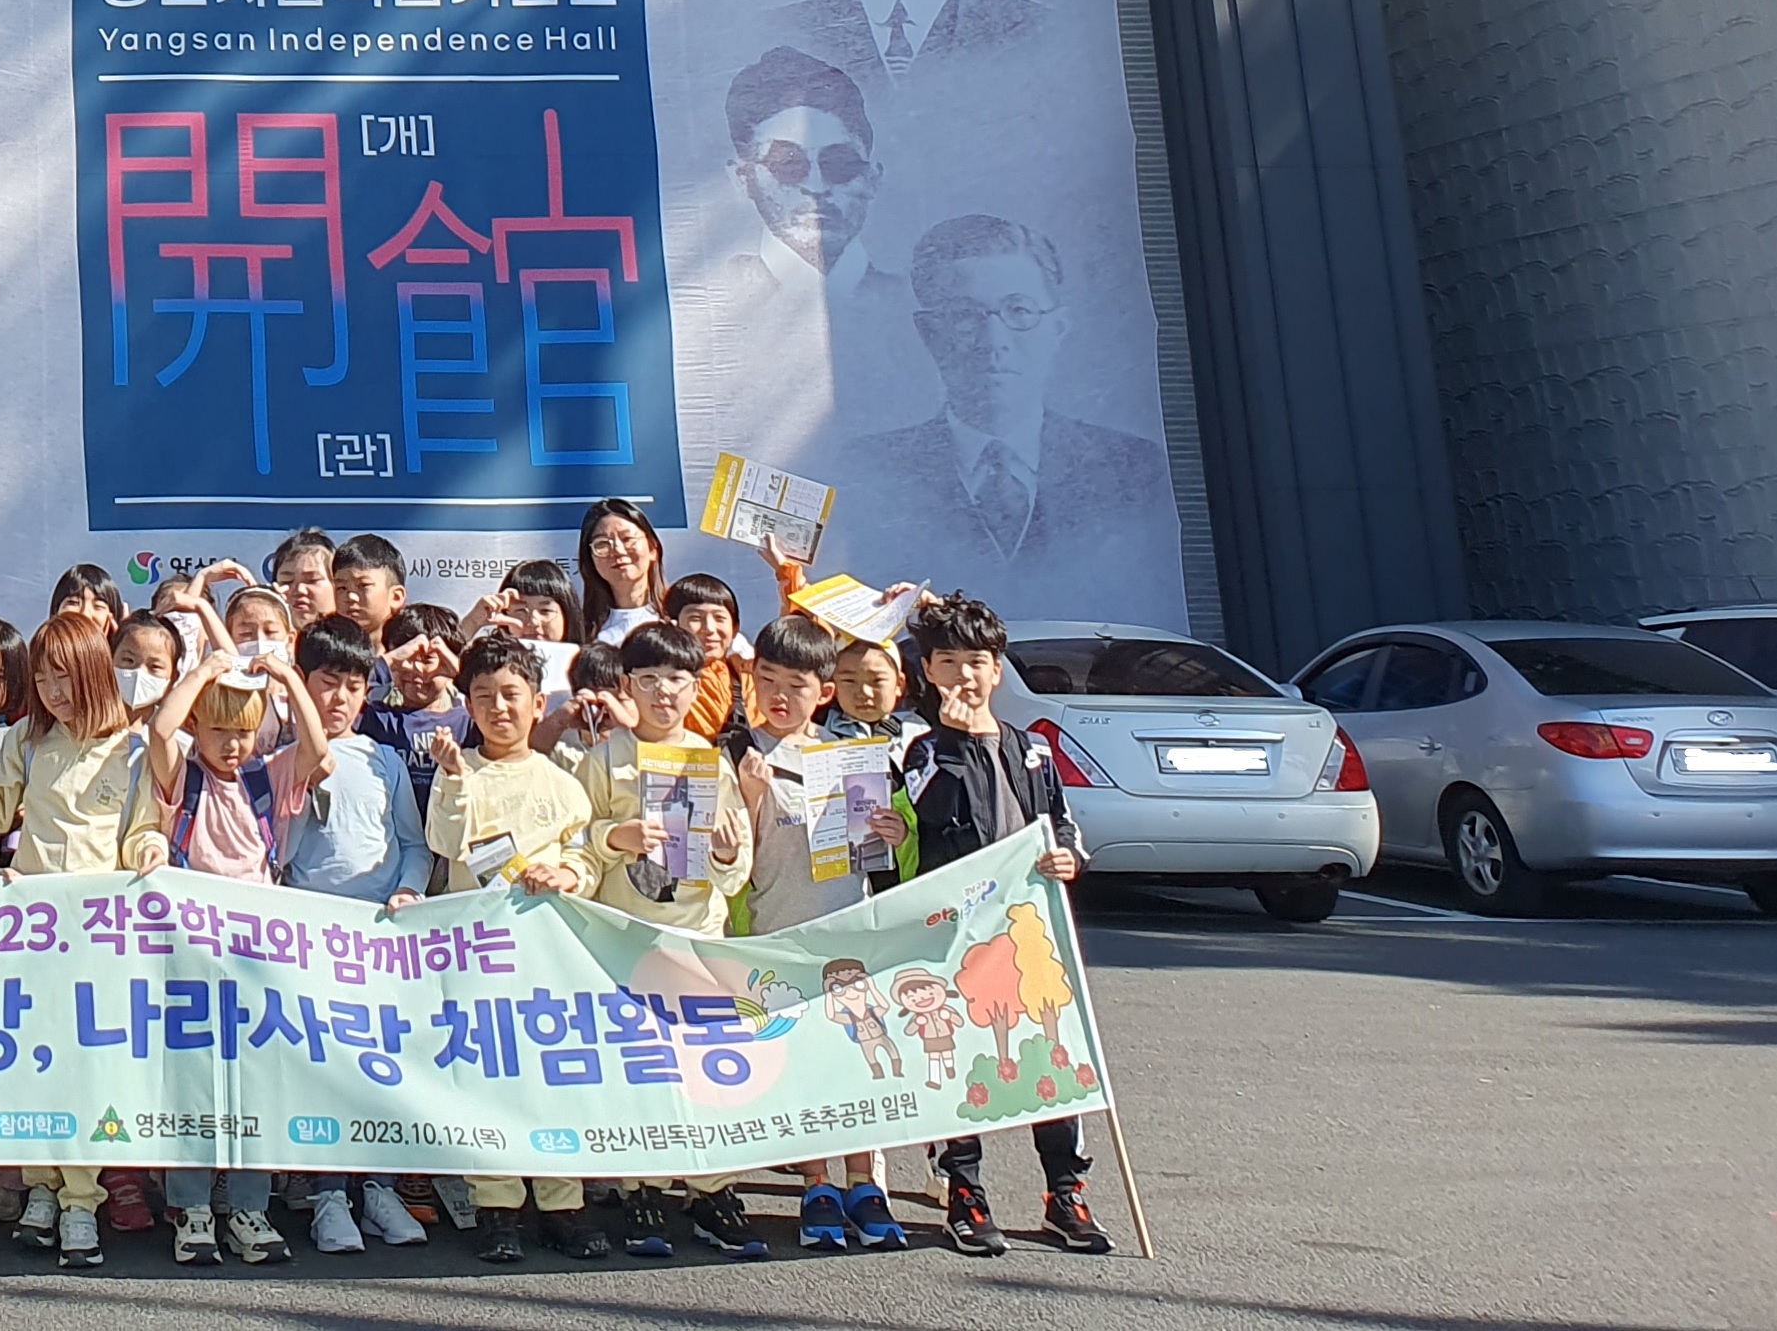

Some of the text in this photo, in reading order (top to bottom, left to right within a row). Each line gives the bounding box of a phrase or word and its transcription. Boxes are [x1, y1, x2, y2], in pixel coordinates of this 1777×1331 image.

[98, 26, 617, 58] Yangsan Independence Hall
[361, 115, 435, 156] [개]
[317, 434, 394, 477] [관]
[82, 891, 313, 970] 작은학교와
[322, 920, 516, 985] 함께하는
[74, 978, 412, 1087] 나라사랑
[430, 986, 754, 1088] 체험활동
[135, 1112, 262, 1140] 영천초등학교
[296, 1119, 333, 1141] 일시
[350, 1120, 507, 1150] 2023.10.12.(목)
[584, 1091, 919, 1153] 양산시립독립기념관 및 춘추공원 일원
[537, 1131, 575, 1150] 장소
